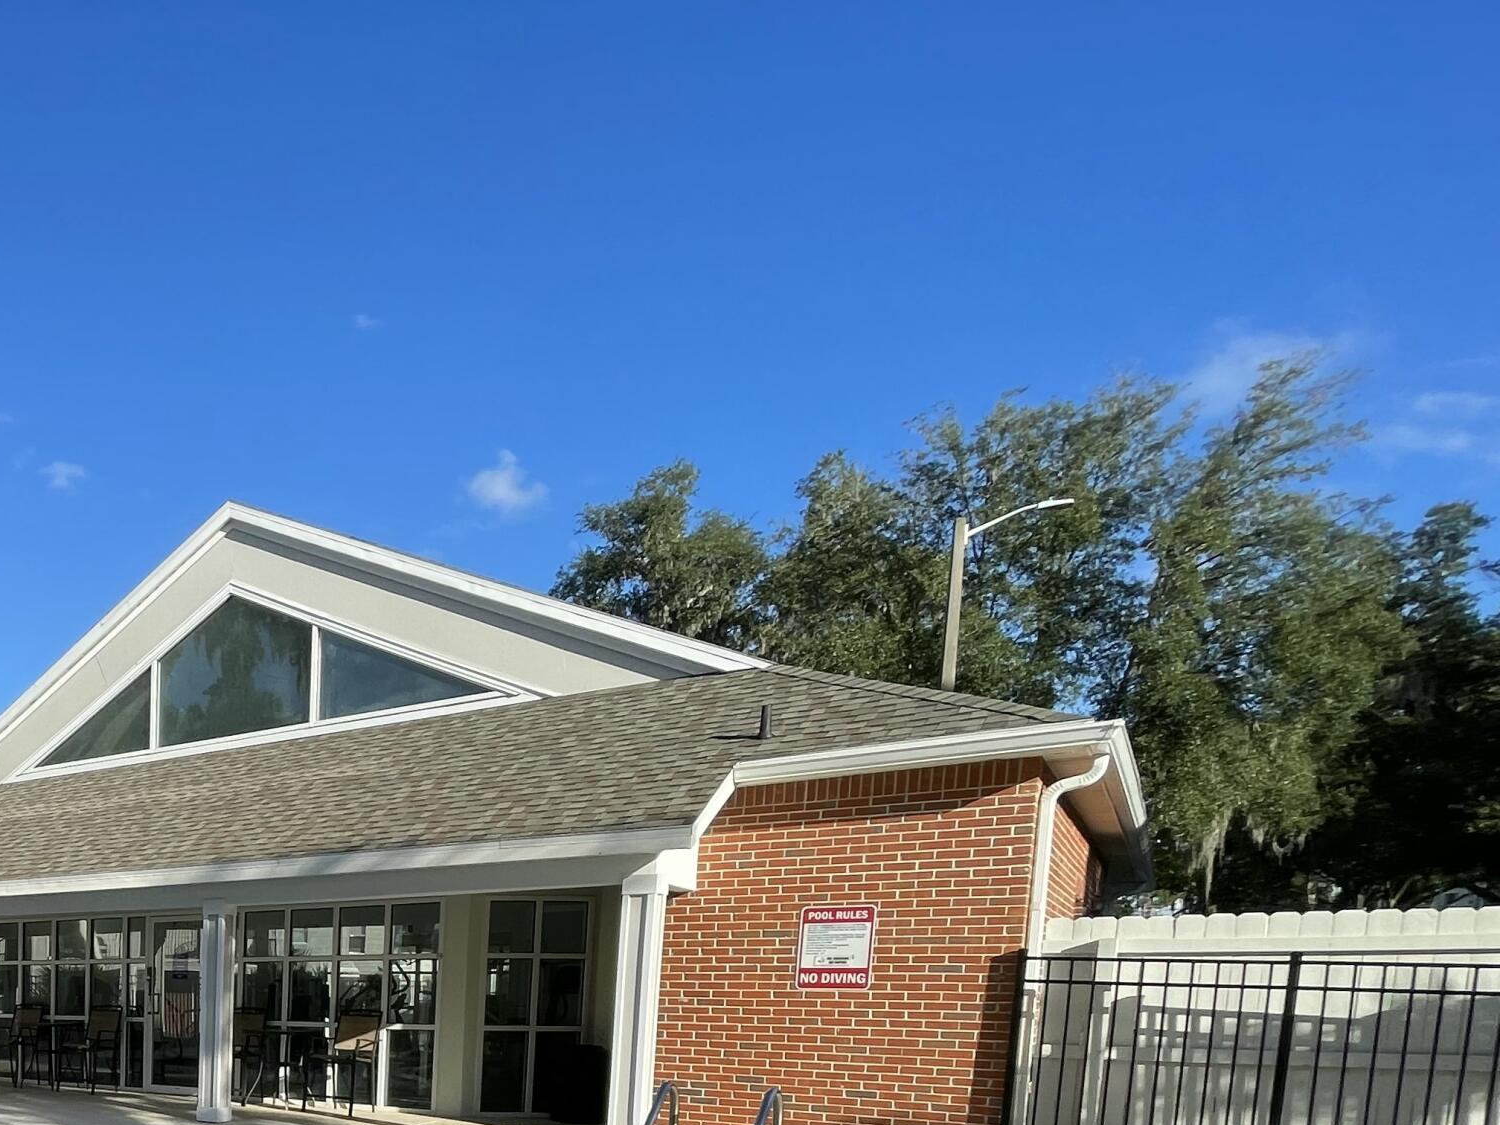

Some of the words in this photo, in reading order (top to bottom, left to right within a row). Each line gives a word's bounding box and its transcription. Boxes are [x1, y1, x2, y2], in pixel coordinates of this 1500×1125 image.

[808, 911, 835, 921] POOL
[836, 910, 869, 920] RULES
[800, 973, 819, 984] NO
[820, 972, 867, 984] DIVING
